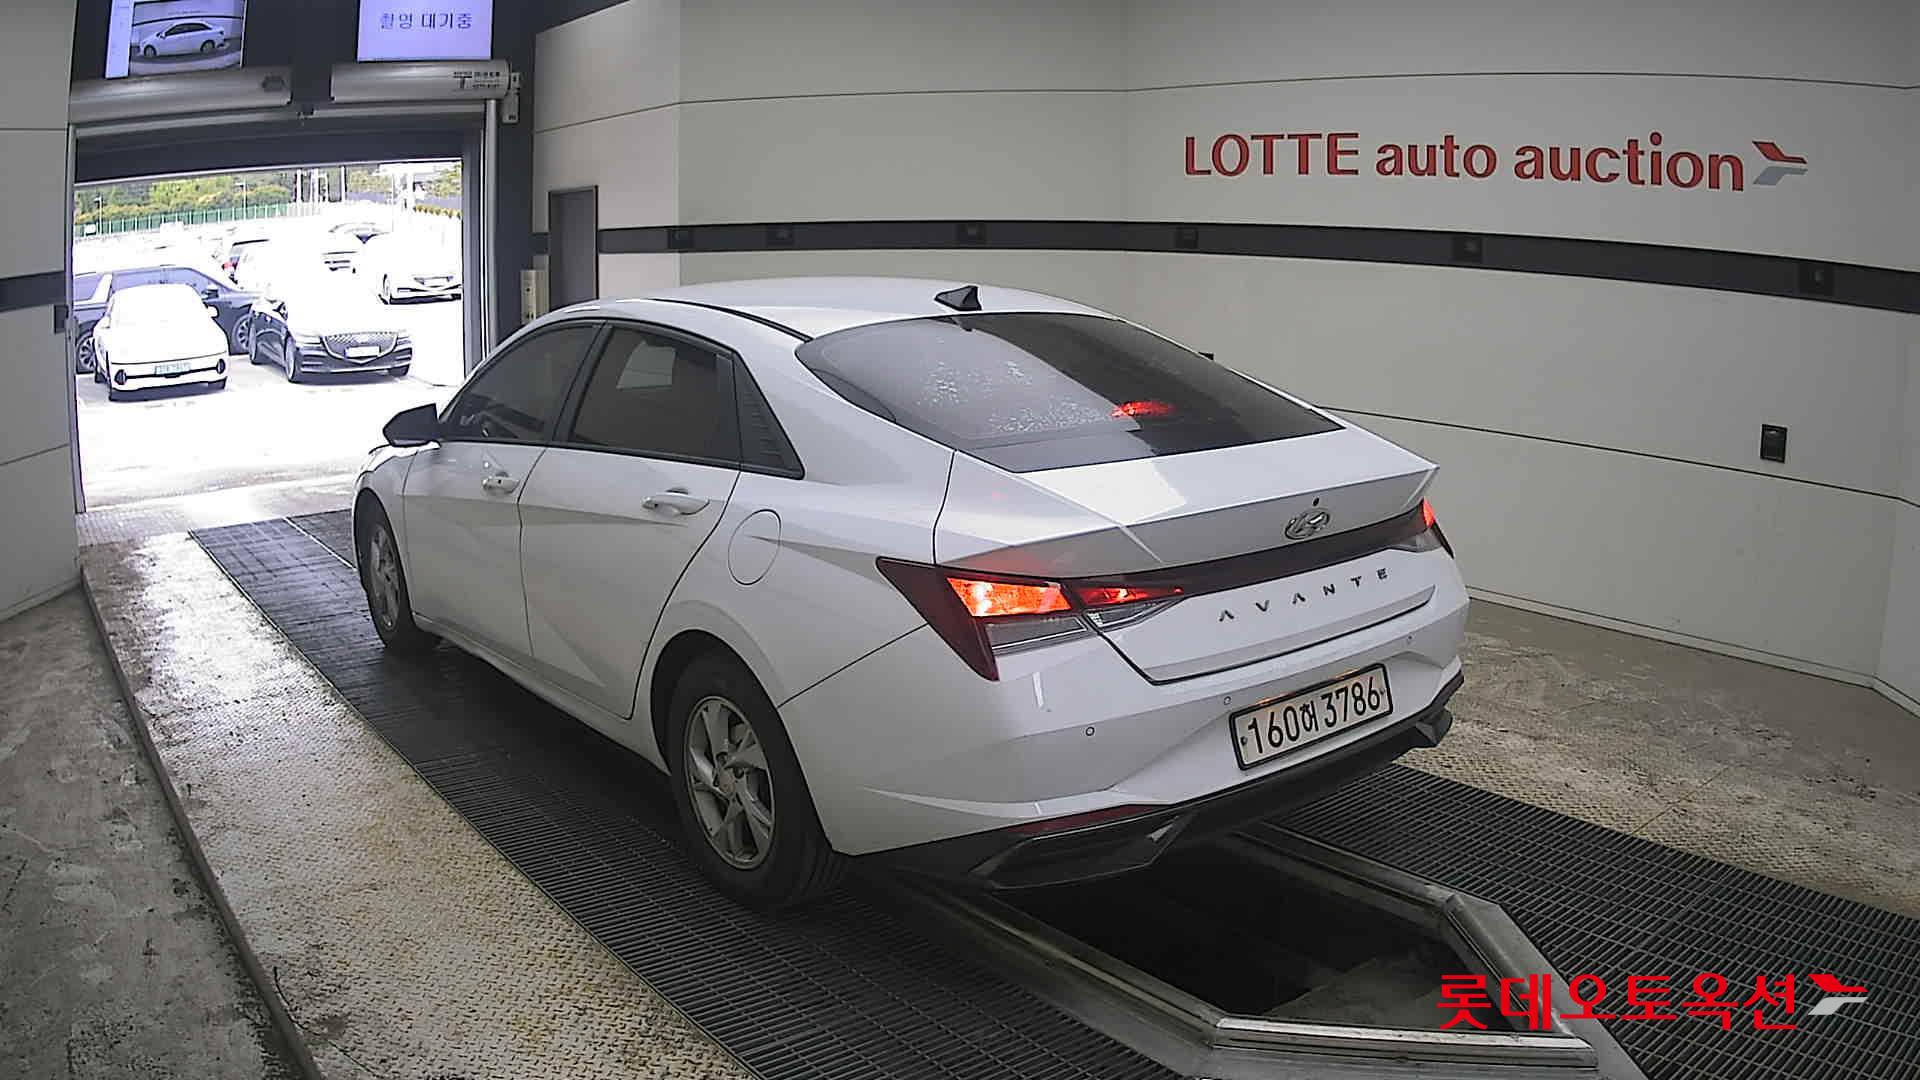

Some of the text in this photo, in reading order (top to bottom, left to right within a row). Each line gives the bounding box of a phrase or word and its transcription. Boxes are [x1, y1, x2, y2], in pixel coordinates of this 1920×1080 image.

[421, 13, 472, 30] 대기중
[1185, 132, 1743, 191] LOTTE auto auction
[1218, 567, 1388, 622] AVANTE
[1321, 676, 1381, 728] 3786
